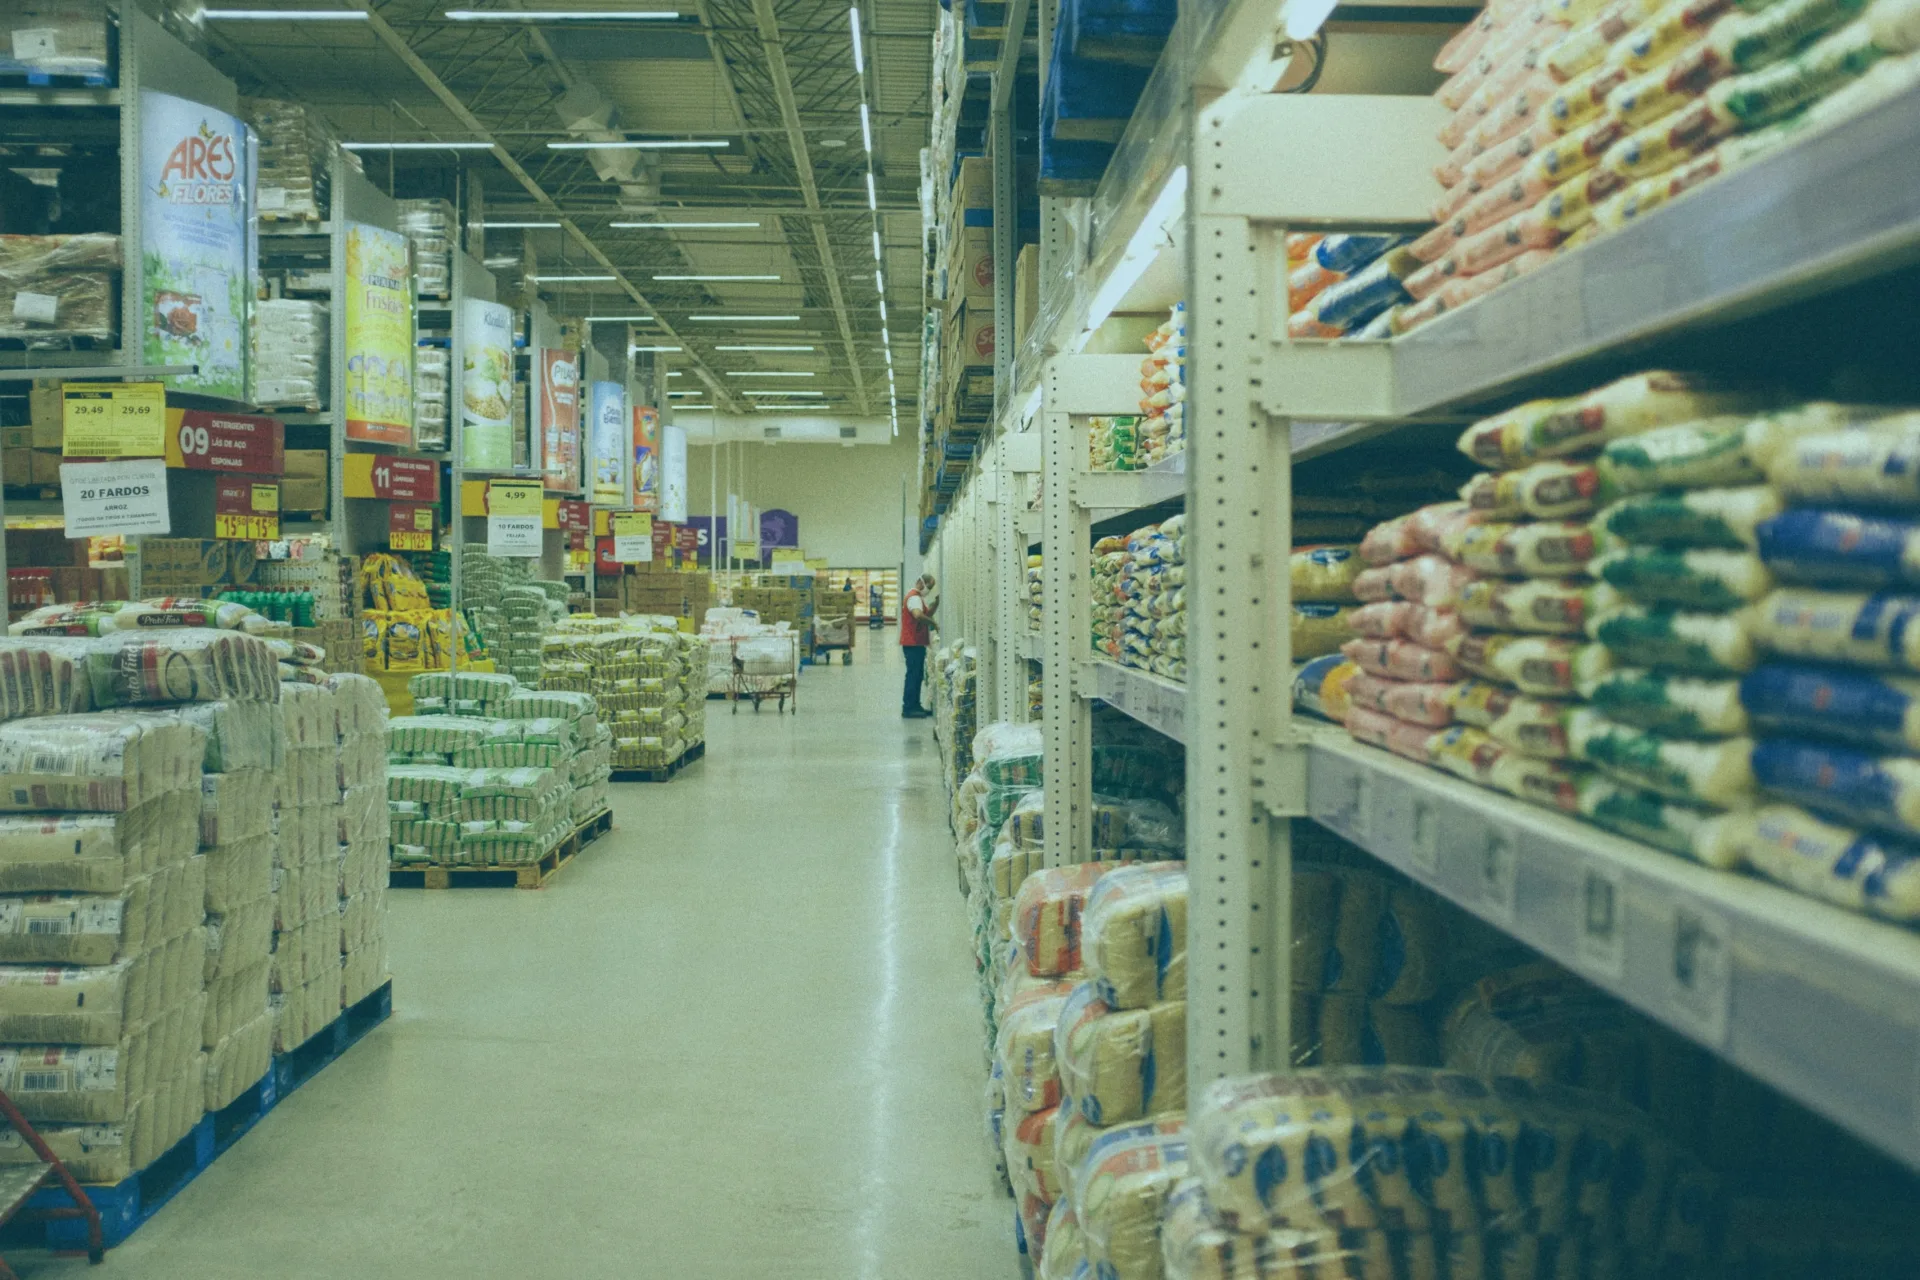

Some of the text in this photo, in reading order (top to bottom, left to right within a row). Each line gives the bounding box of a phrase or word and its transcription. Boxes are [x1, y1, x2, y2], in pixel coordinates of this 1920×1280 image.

[162, 135, 235, 181] ARES
[170, 183, 234, 205] FLORES
[366, 290, 404, 314] Friskies
[75, 406, 151, 416] 29,49 29,69
[211, 420, 255, 431] DETERGENTES
[180, 426, 209, 455] 09
[224, 439, 233, 448] DE
[211, 457, 243, 466] ESPONJAS
[376, 467, 390, 488] 11
[80, 485, 150, 499] 20 FARDOS
[505, 492, 526, 500] 4,99
[164, 614, 180, 624] Fino
